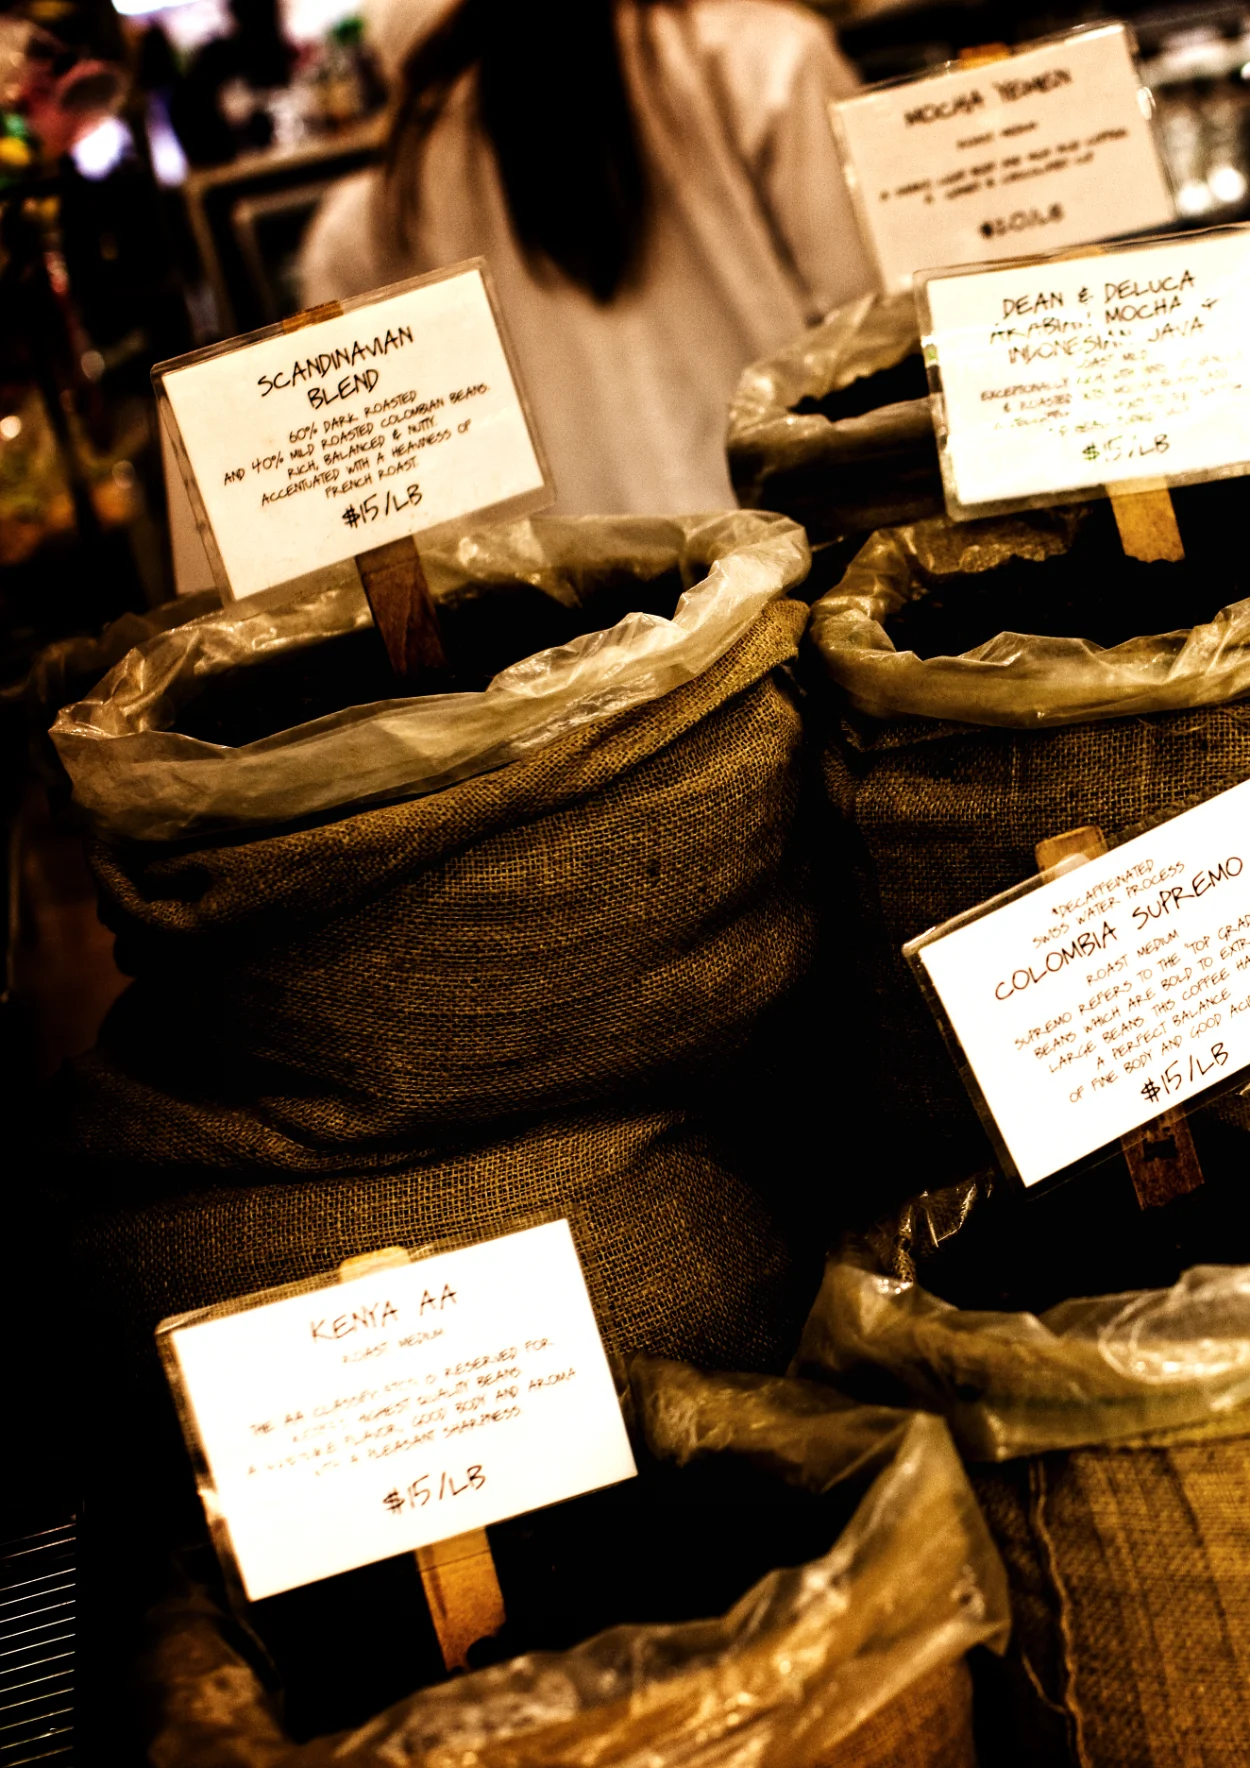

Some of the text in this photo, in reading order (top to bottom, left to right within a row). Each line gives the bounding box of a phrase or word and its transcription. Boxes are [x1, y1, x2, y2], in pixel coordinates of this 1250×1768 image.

[904, 90, 984, 126] MOCHA
[1003, 270, 1195, 320] DEAN & DELUCA
[1105, 295, 1182, 324] MOCHA
[1147, 316, 1204, 342] JAVA
[257, 326, 414, 397] SCANDINAVIAN
[307, 369, 379, 410] BLEND
[224, 468, 245, 486] AND
[252, 451, 284, 474] 40%
[290, 439, 315, 460] MILD
[321, 422, 374, 451] ROASTED
[380, 398, 445, 428] COLOMBIAN
[289, 390, 417, 444] 60% DARK ROASTED
[262, 419, 471, 507] ACCENTUATED WITH A HEAVINESS OF
[323, 435, 385, 466] BALANCED
[392, 428, 402, 441] &
[325, 473, 373, 498] FRENCH
[342, 484, 422, 529] $15/LB
[995, 857, 1243, 1000] COLOMBIA SUPREMO
[1032, 861, 1184, 948] SWISS WATER PROCESS
[1086, 929, 1179, 986] ROAST MEDIUM
[1015, 1012, 1072, 1050] SUPREMO
[1078, 980, 1132, 1015] REFERS
[1136, 969, 1152, 983] TO
[1157, 953, 1181, 971] THE
[1184, 936, 1210, 954] "TOP
[1034, 1032, 1076, 1059] BEANS
[1084, 1006, 1120, 1033] WHICH
[1128, 988, 1155, 1012] ARE
[1161, 967, 1192, 991] BOLD
[1197, 957, 1213, 971] TO
[1049, 1040, 1096, 1073] LARGE
[1151, 999, 1175, 1016] THIS
[1182, 968, 1230, 1001] COFFEE
[1097, 988, 1231, 1070] A PERFECT BALANCE
[1069, 1086, 1084, 1103] OF
[1091, 1070, 1118, 1091] FINE
[1124, 1049, 1152, 1074] BODY
[1162, 1035, 1182, 1056] AND
[1190, 1013, 1221, 1038] GOOD
[1141, 1042, 1228, 1102] $15/LB
[311, 1284, 456, 1341] KENYA AA
[382, 1465, 486, 1513] $15/LB
